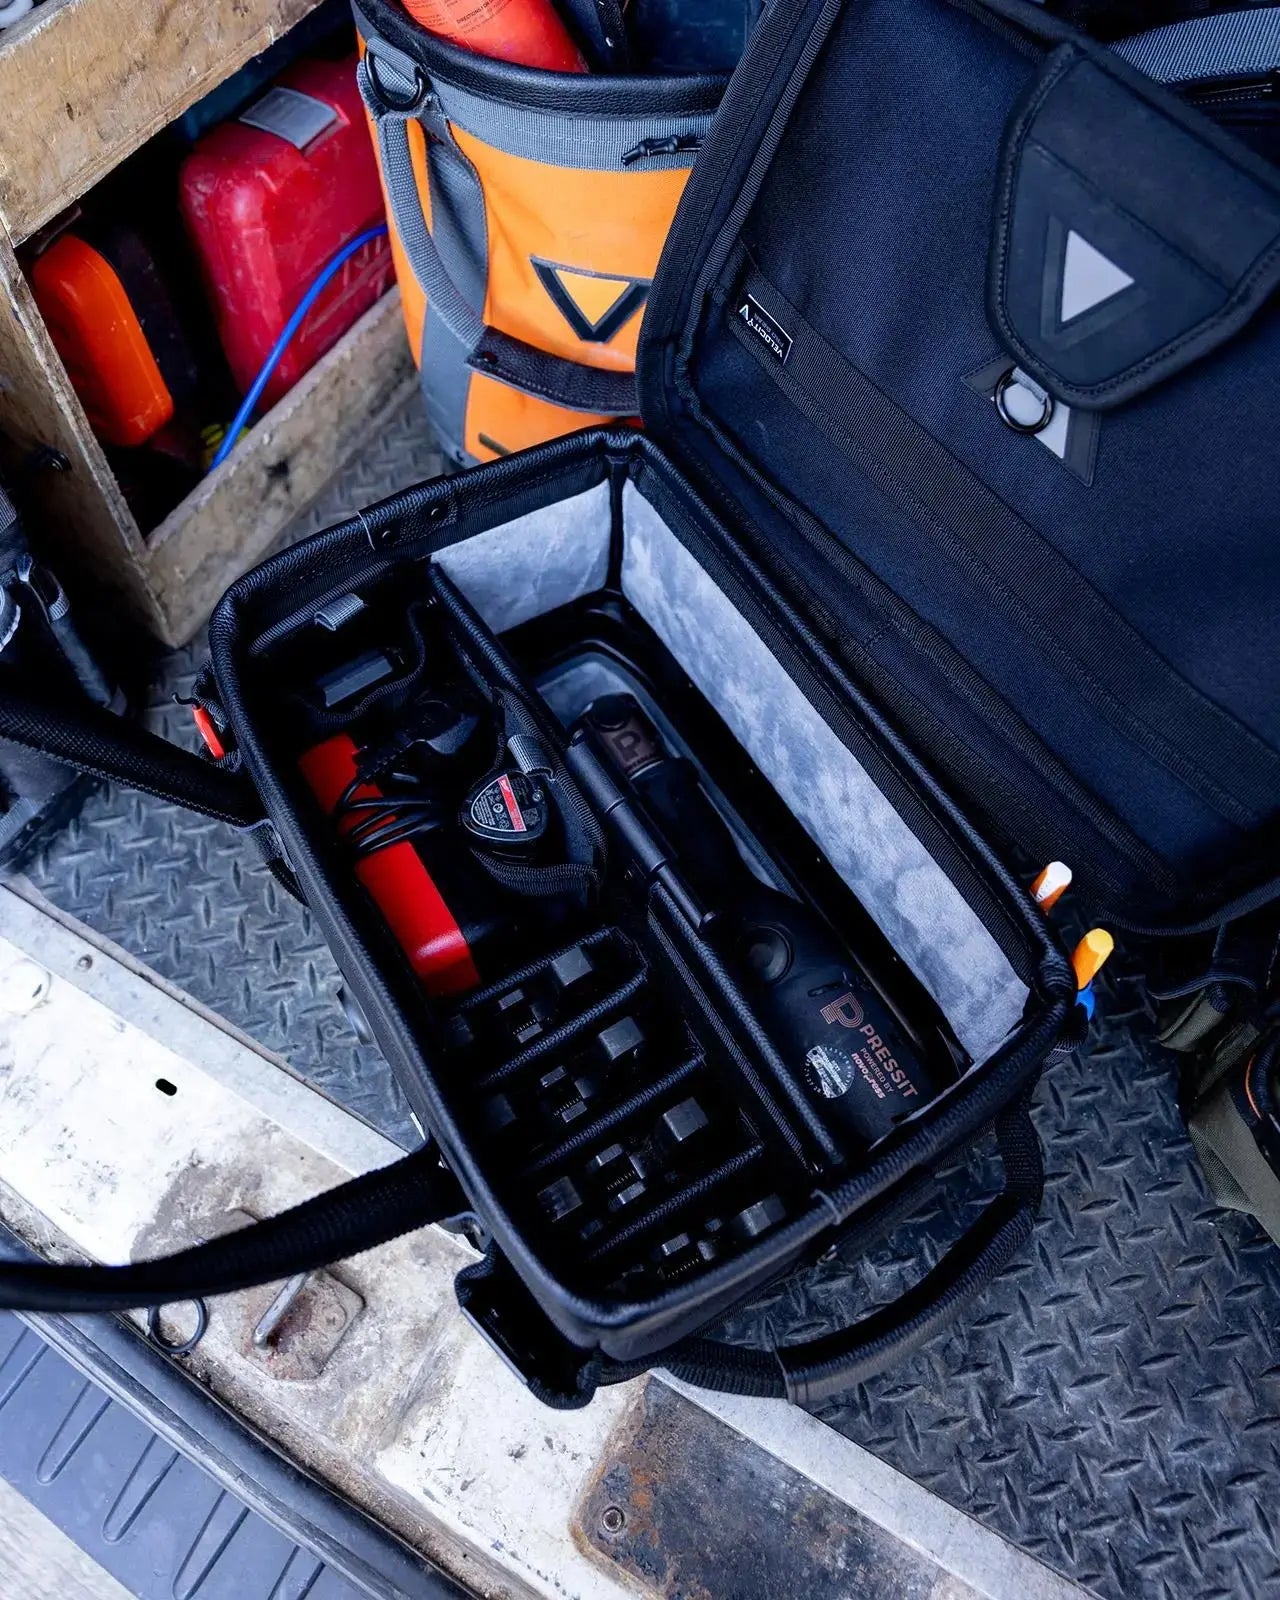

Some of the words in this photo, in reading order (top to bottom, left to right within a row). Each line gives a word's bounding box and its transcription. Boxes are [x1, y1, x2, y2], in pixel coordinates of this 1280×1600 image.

[747, 319, 783, 358] VELOCITY
[859, 1023, 918, 1097] PRESSIT
[860, 1048, 889, 1082] POWERED
[883, 1081, 895, 1092] BY
